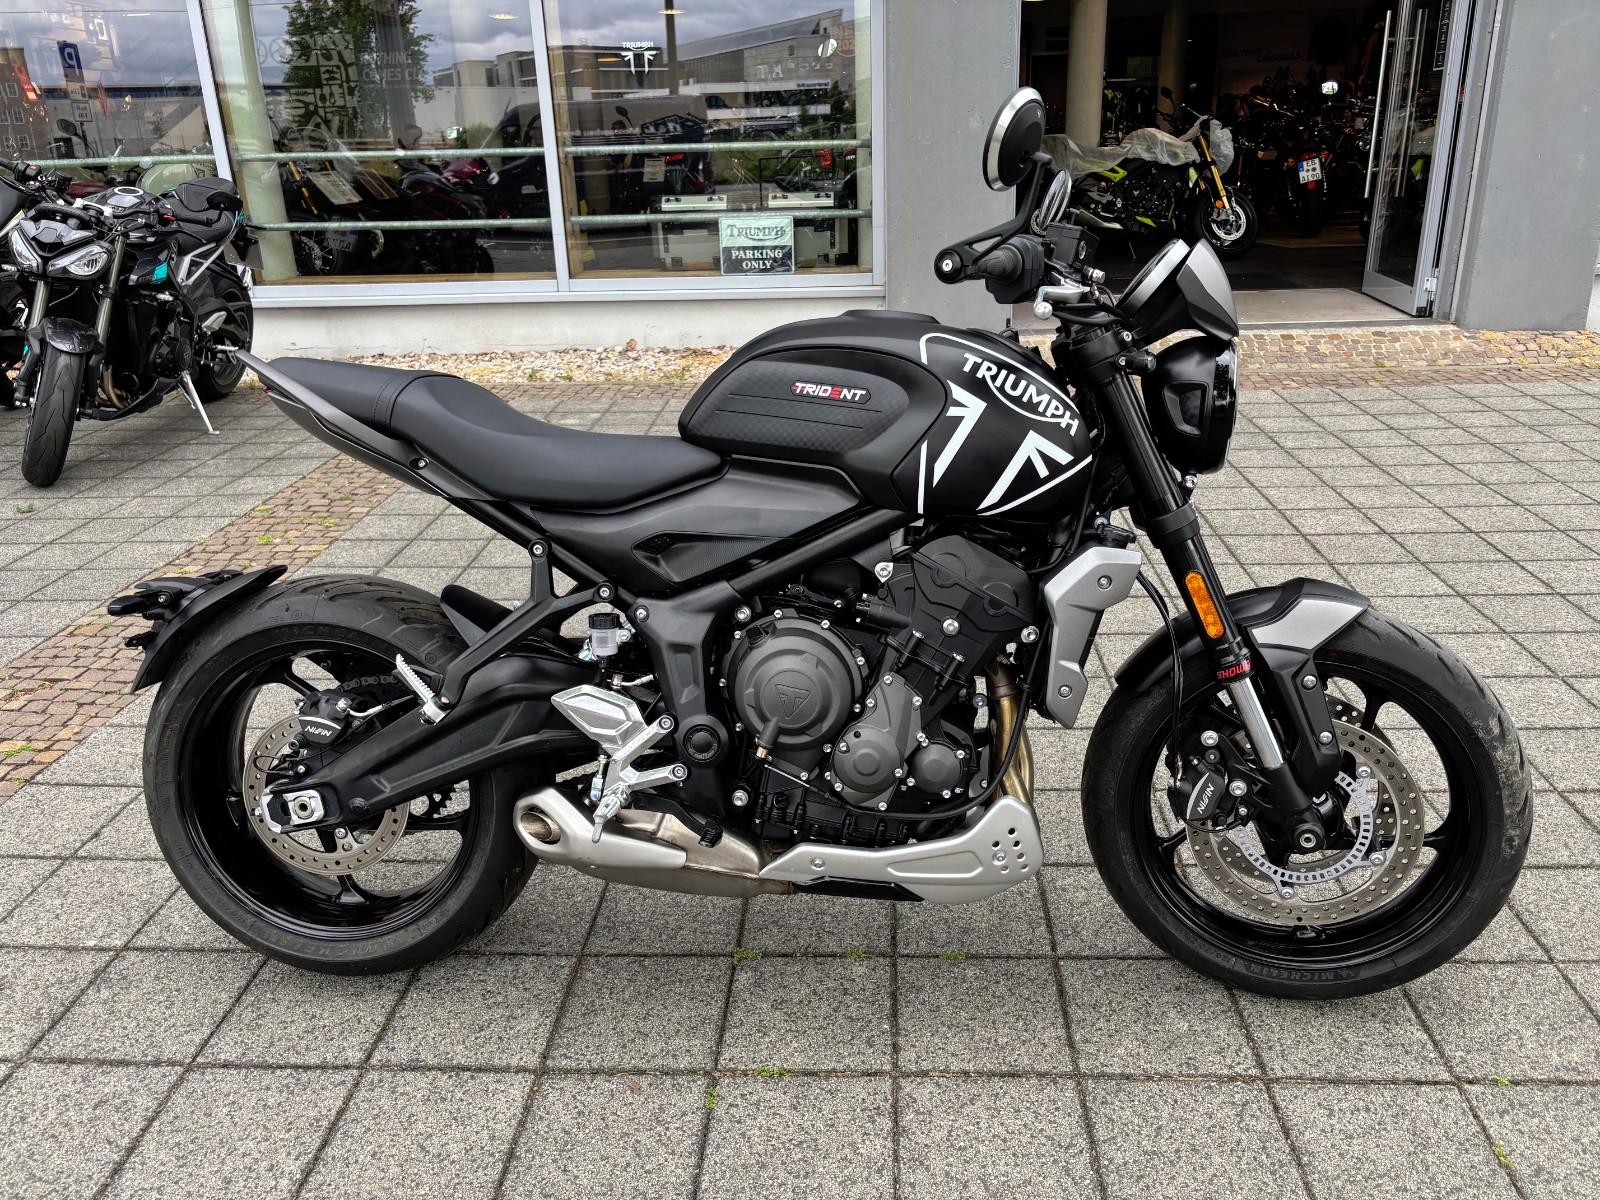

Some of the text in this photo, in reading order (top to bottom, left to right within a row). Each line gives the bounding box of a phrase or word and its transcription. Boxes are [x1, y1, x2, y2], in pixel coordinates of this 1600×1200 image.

[731, 249, 783, 259] PARKING
[742, 260, 773, 269] ONLY
[793, 382, 867, 401] TRIDENT
[961, 352, 1080, 437] TRIUMPH
